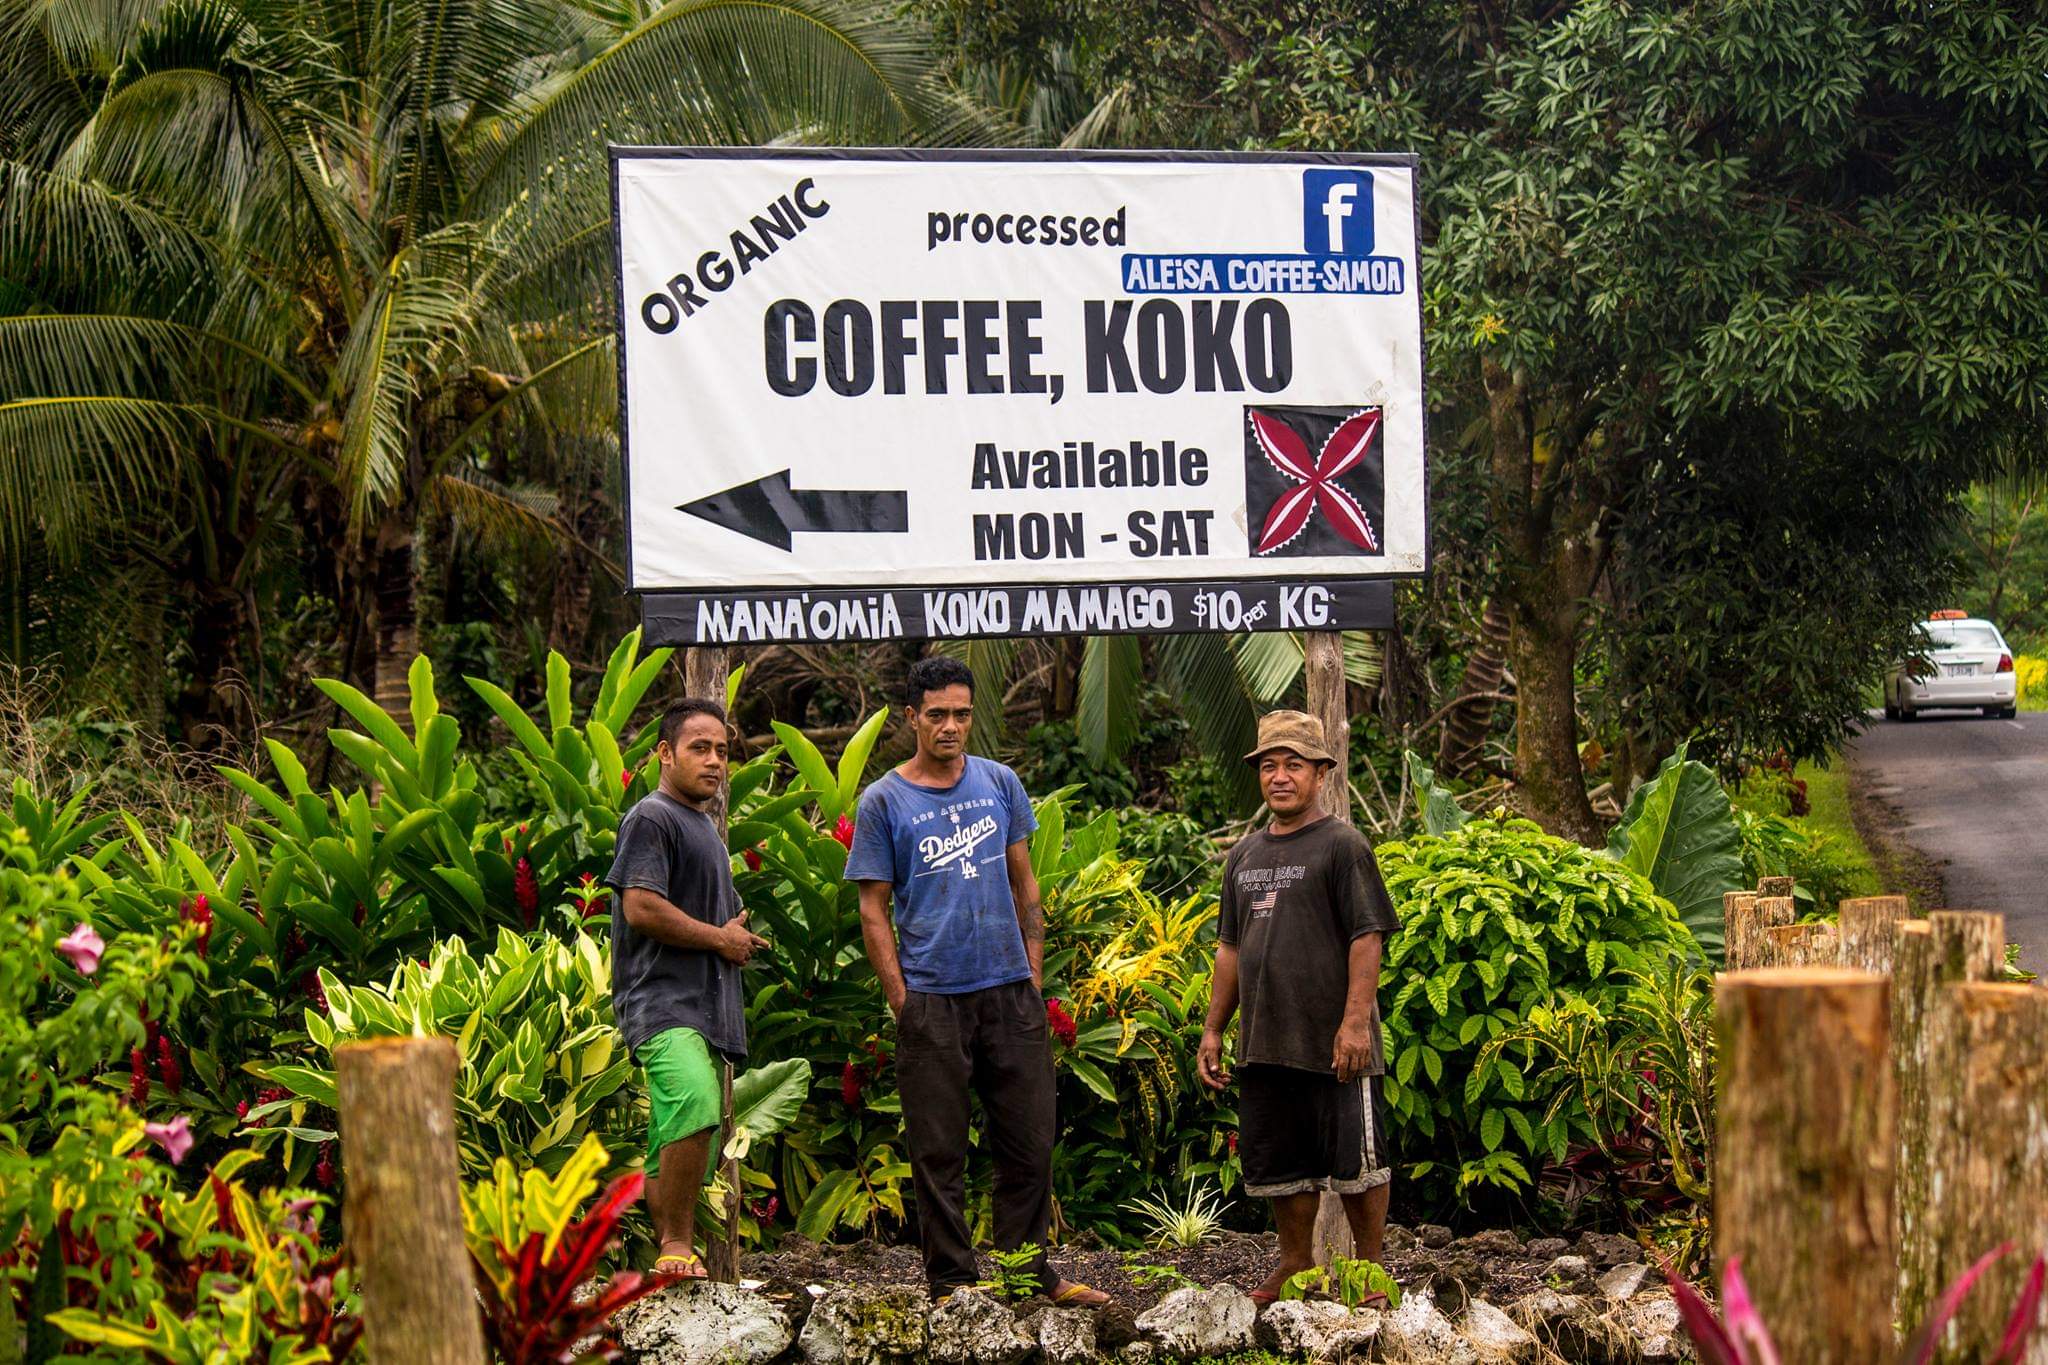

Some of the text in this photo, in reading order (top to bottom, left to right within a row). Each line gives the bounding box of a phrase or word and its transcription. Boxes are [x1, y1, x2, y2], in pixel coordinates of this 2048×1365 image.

[927, 205, 1127, 252] processed
[641, 177, 831, 335] ORGANIC
[763, 297, 1293, 406] COFFEE, KOKO
[971, 440, 1209, 490] Available
[972, 511, 1086, 561] MON
[1127, 509, 1215, 558] SAT
[923, 589, 1012, 638] KOKO
[1021, 585, 1175, 632] MAMAGO
[1190, 587, 1242, 631] $10
[1241, 598, 1269, 632] per
[911, 797, 995, 826] LOS ANGELES
[918, 814, 998, 870] Dodgers
[958, 857, 980, 880] LA
[1274, 865, 1306, 881] BEACH
